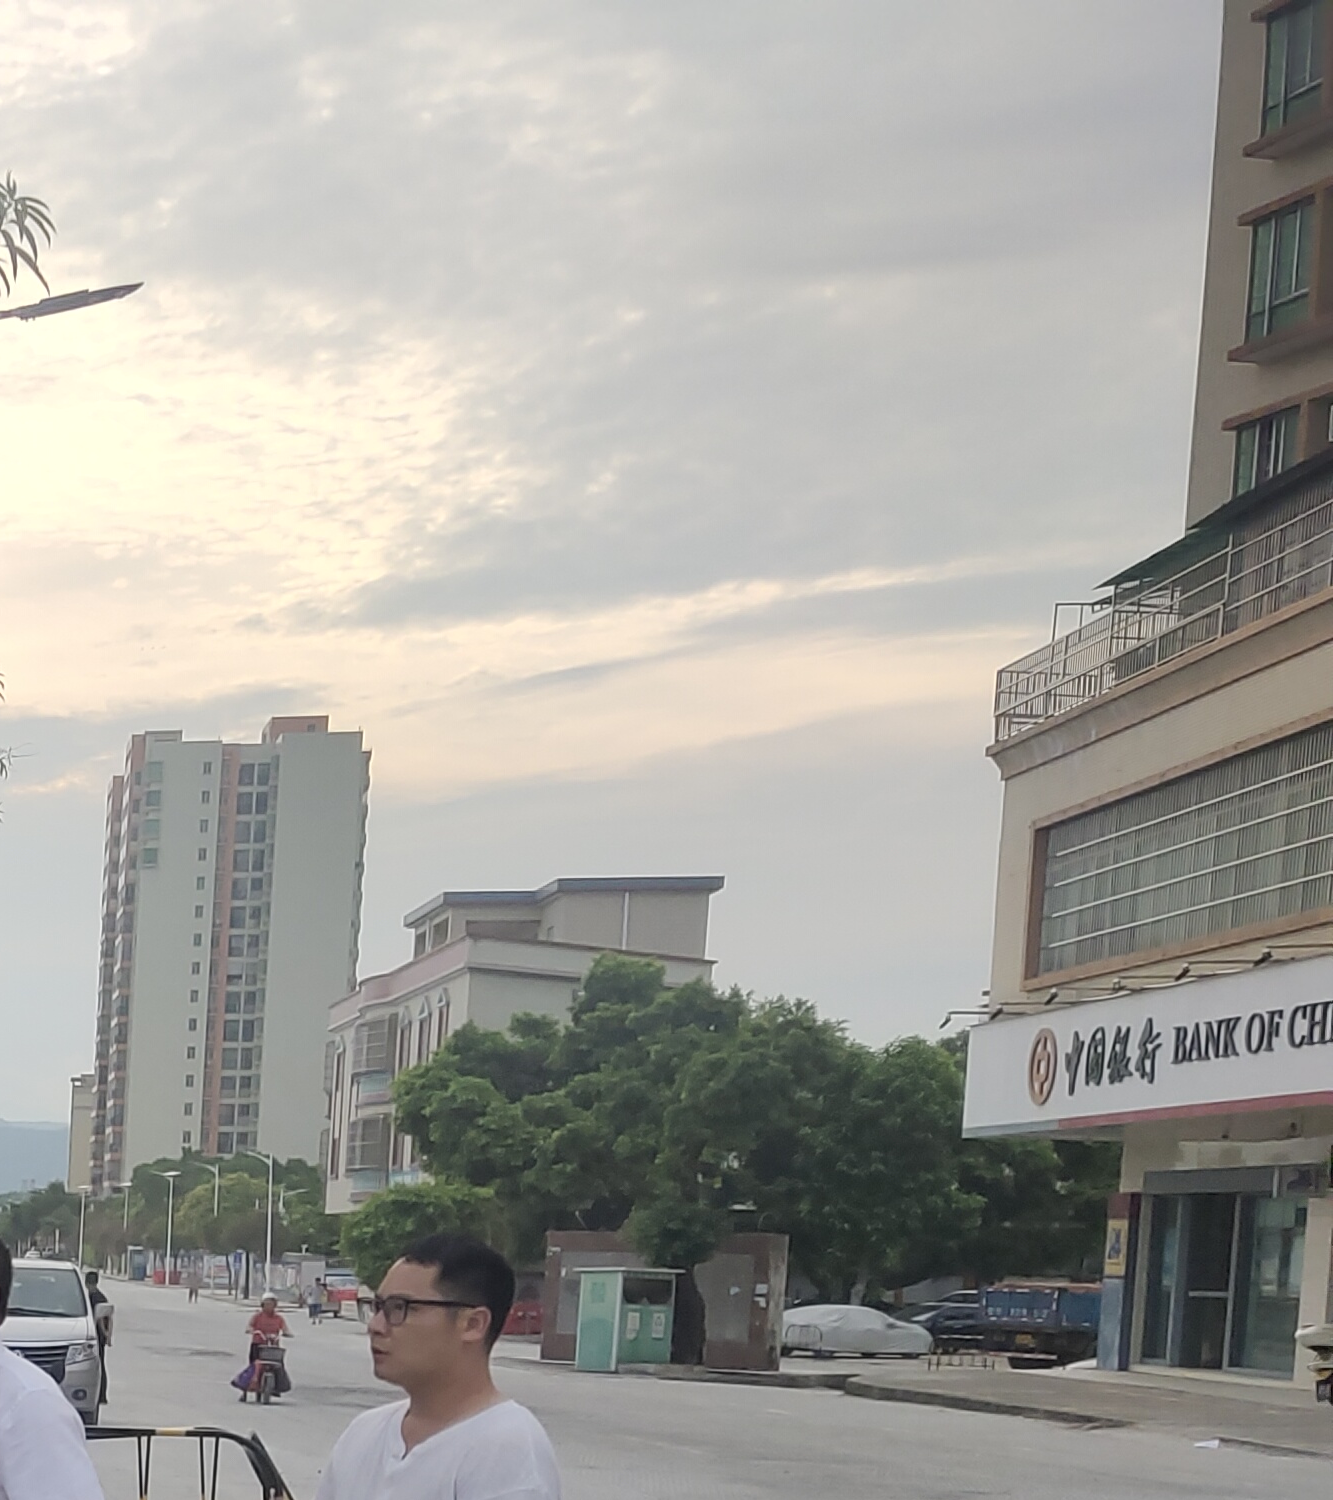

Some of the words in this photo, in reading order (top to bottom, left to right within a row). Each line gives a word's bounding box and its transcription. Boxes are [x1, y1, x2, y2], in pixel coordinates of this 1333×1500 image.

[1063, 1016, 1163, 1097] 中国银行
[1170, 1016, 1242, 1065] BANK
[1245, 1009, 1284, 1054] OF
